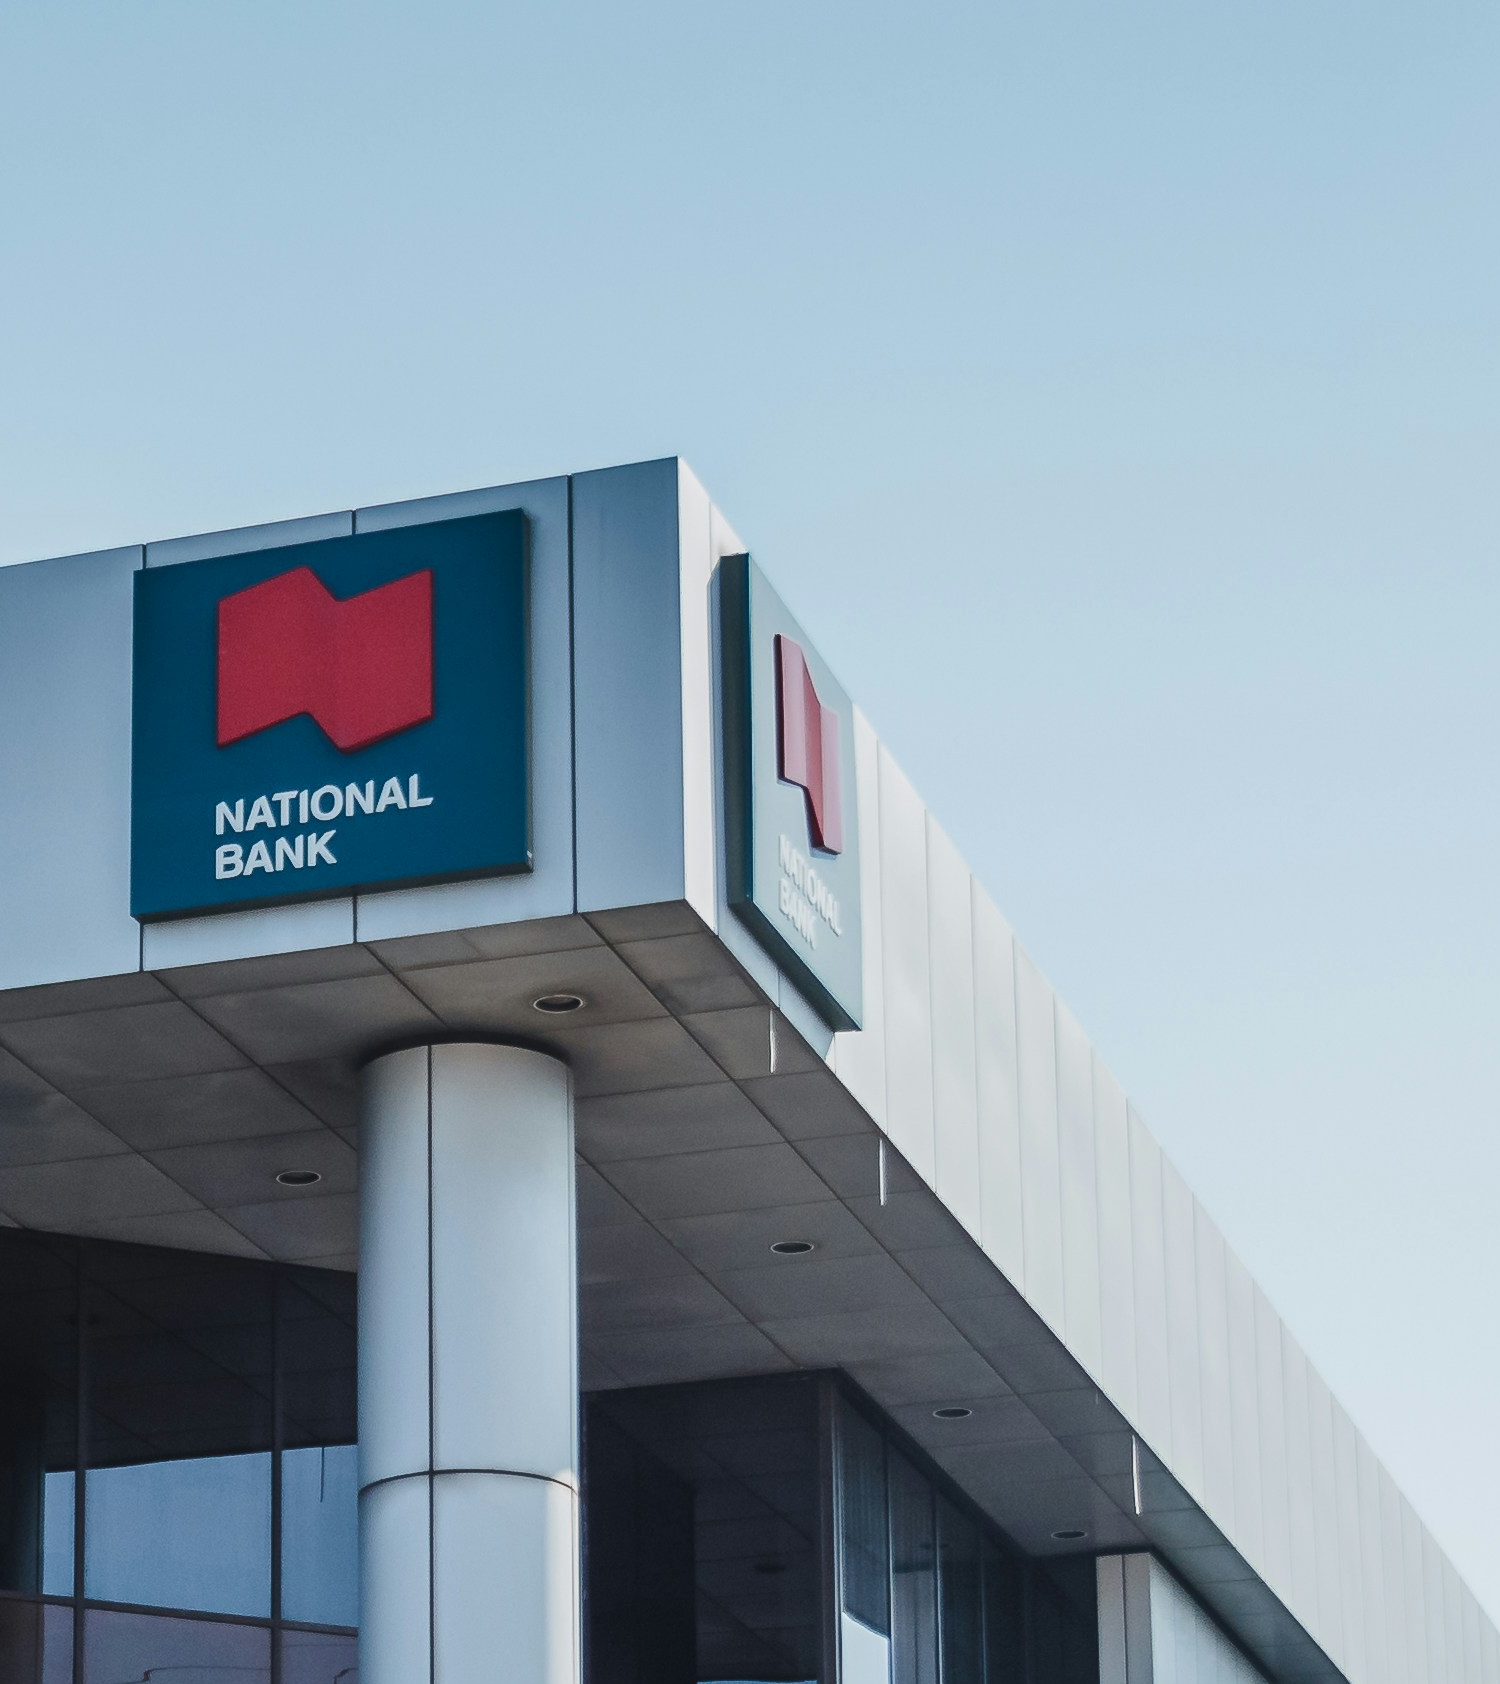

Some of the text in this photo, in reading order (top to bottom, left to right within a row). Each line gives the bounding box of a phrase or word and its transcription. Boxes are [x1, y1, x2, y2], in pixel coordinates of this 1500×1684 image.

[215, 772, 434, 836] NATIONAL
[214, 829, 338, 881] BANK
[778, 833, 843, 937] NATIONAL
[778, 878, 816, 951] BANK
